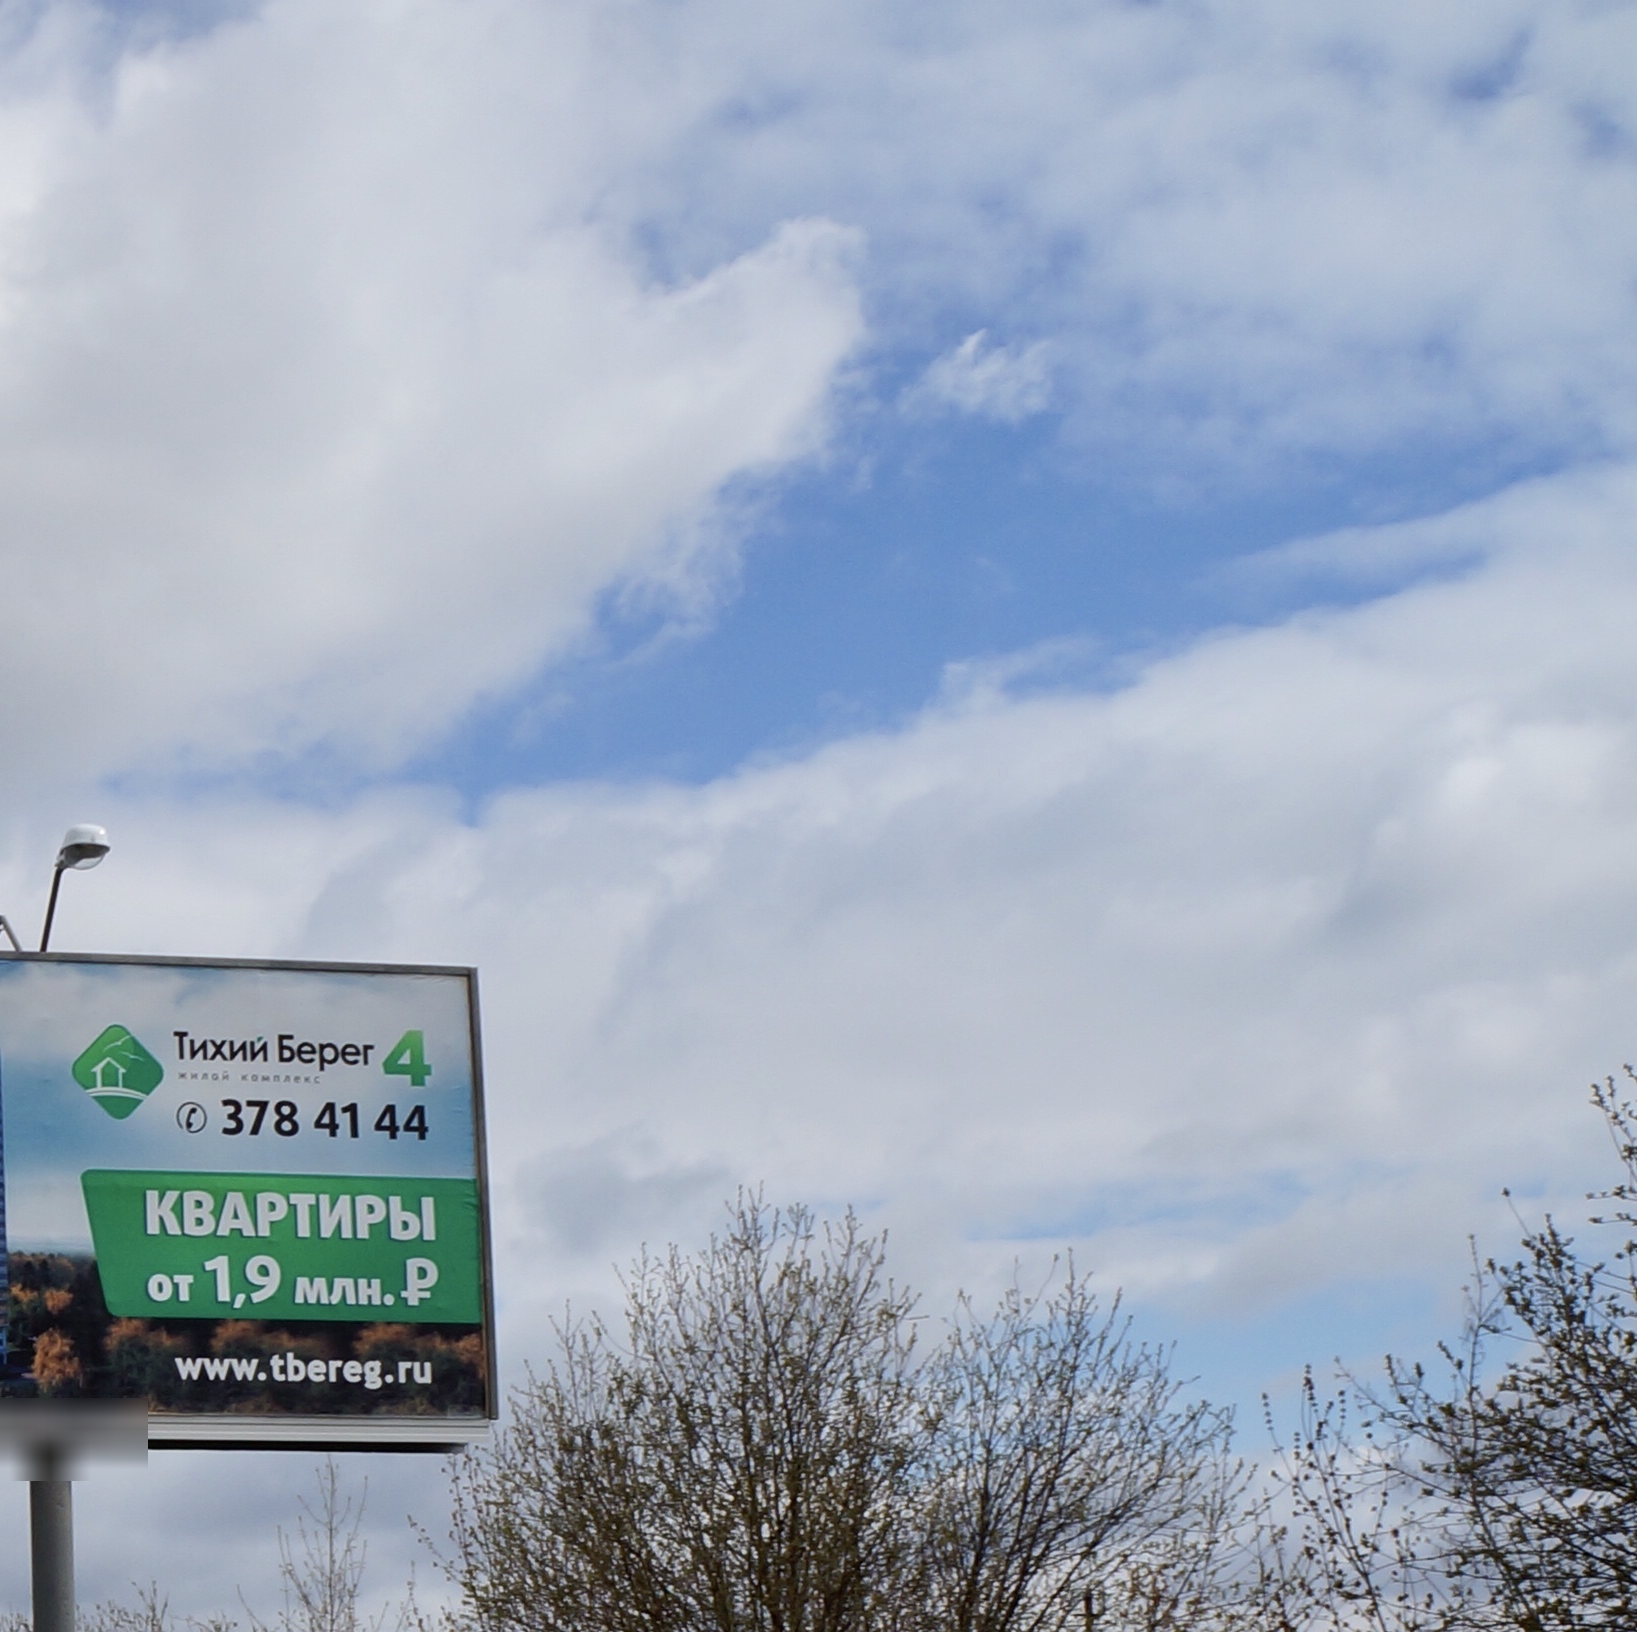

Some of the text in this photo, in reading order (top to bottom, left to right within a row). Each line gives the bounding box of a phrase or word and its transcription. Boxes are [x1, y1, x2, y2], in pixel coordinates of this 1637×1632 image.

[173, 1029, 433, 1087] Тихий Берег 4
[177, 1070, 322, 1084] жилой комплекс
[221, 1098, 429, 1140] 378 41 44
[145, 1189, 437, 1241] КВАРТИРЫ
[146, 1273, 194, 1302] от
[203, 1254, 283, 1309] 1,9
[293, 1276, 395, 1306] млн.
[174, 1352, 433, 1390] www.tbereg.ru
